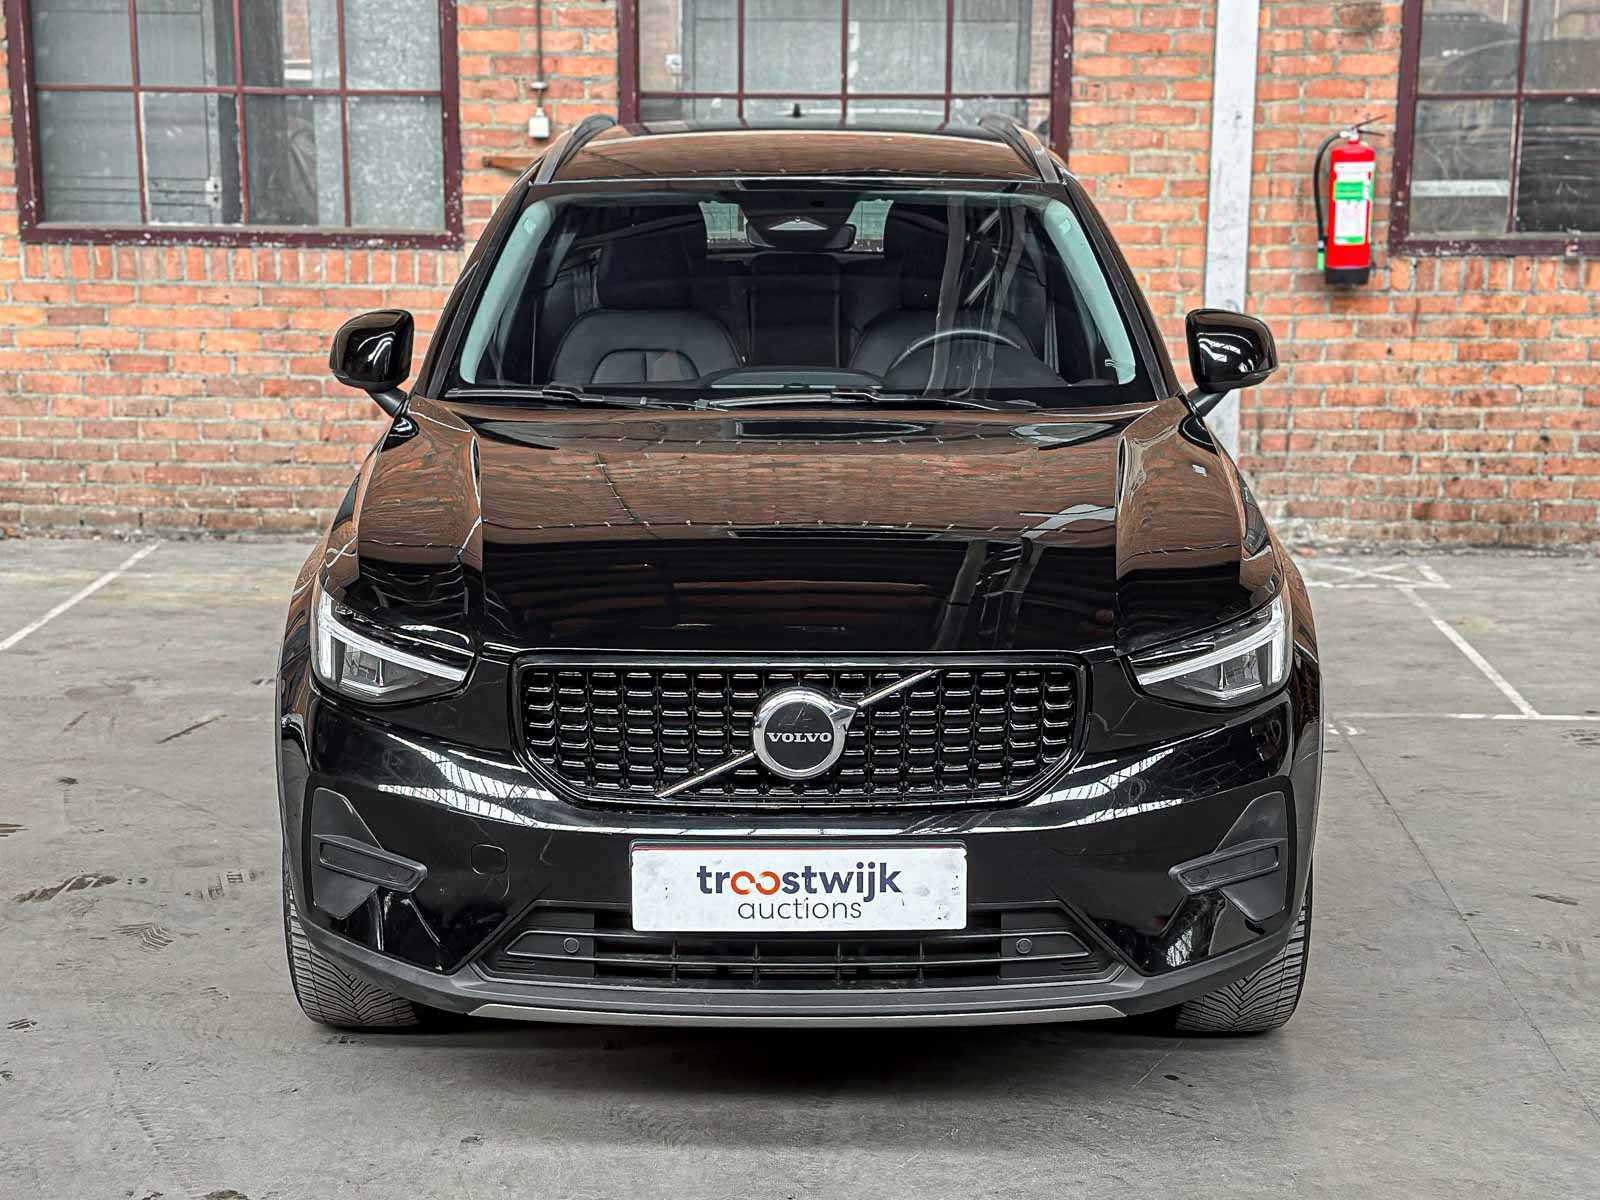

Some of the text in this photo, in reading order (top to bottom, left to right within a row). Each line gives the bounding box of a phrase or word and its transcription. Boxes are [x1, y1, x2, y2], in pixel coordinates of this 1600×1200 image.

[766, 732, 832, 743] VOLVO
[696, 862, 902, 903] troostwijk
[737, 897, 862, 920] auctions
